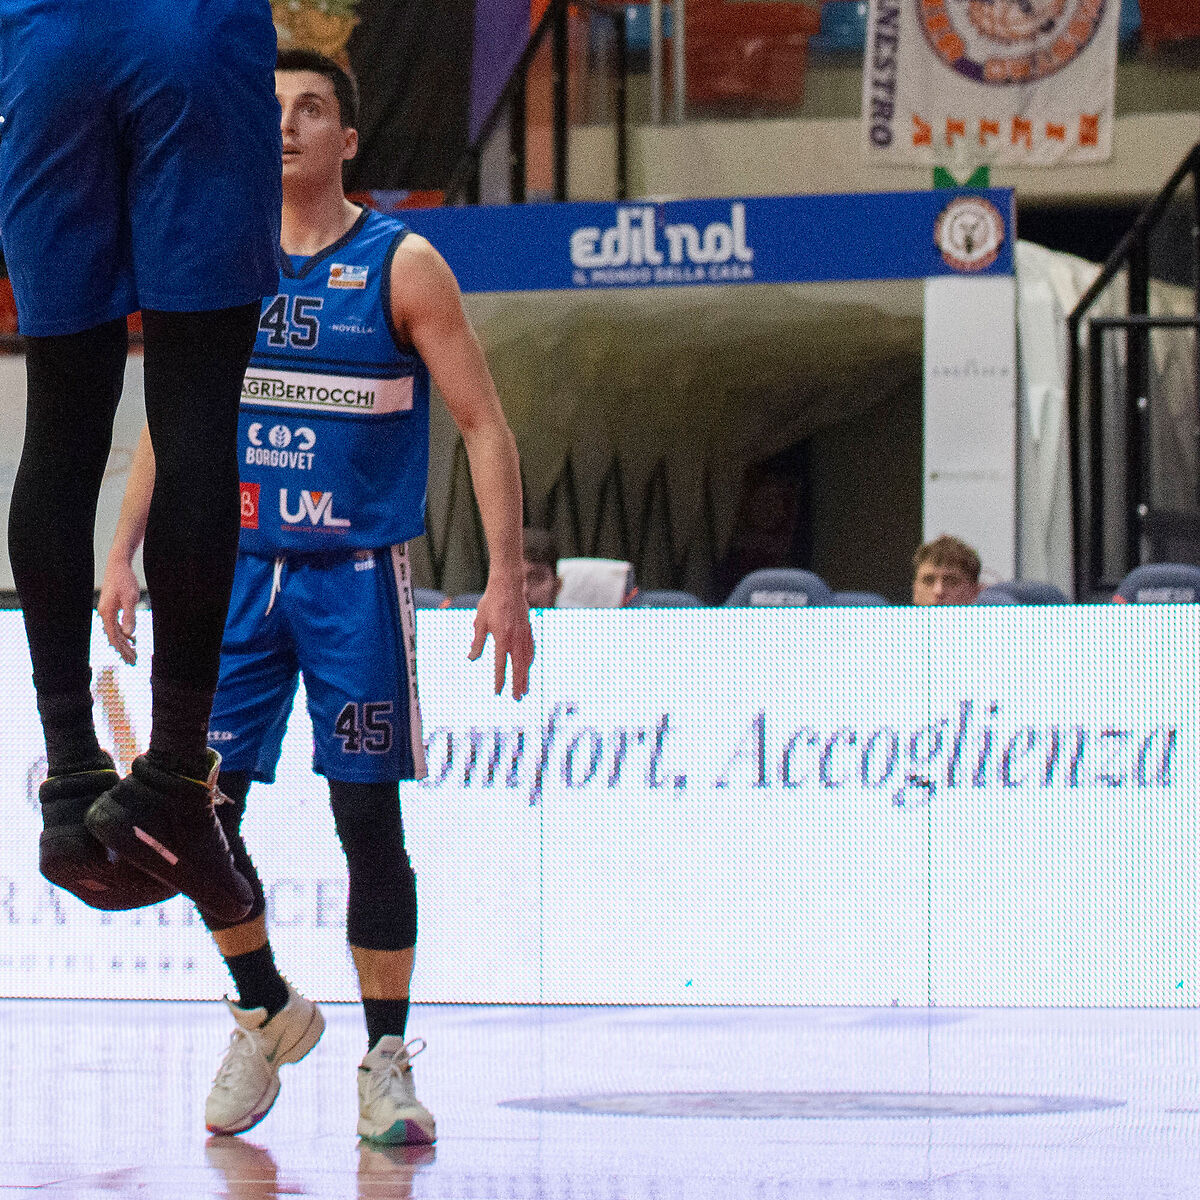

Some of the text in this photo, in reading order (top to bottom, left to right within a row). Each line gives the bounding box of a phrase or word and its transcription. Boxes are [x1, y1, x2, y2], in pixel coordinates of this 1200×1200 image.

[259, 293, 324, 351] 45
[241, 376, 376, 408] AGRIBERTOCCHI
[245, 446, 315, 470] BORGOVET
[279, 488, 351, 526] UVL
[333, 701, 394, 755] 45
[417, 700, 1179, 809] omfort, Accoglienza
